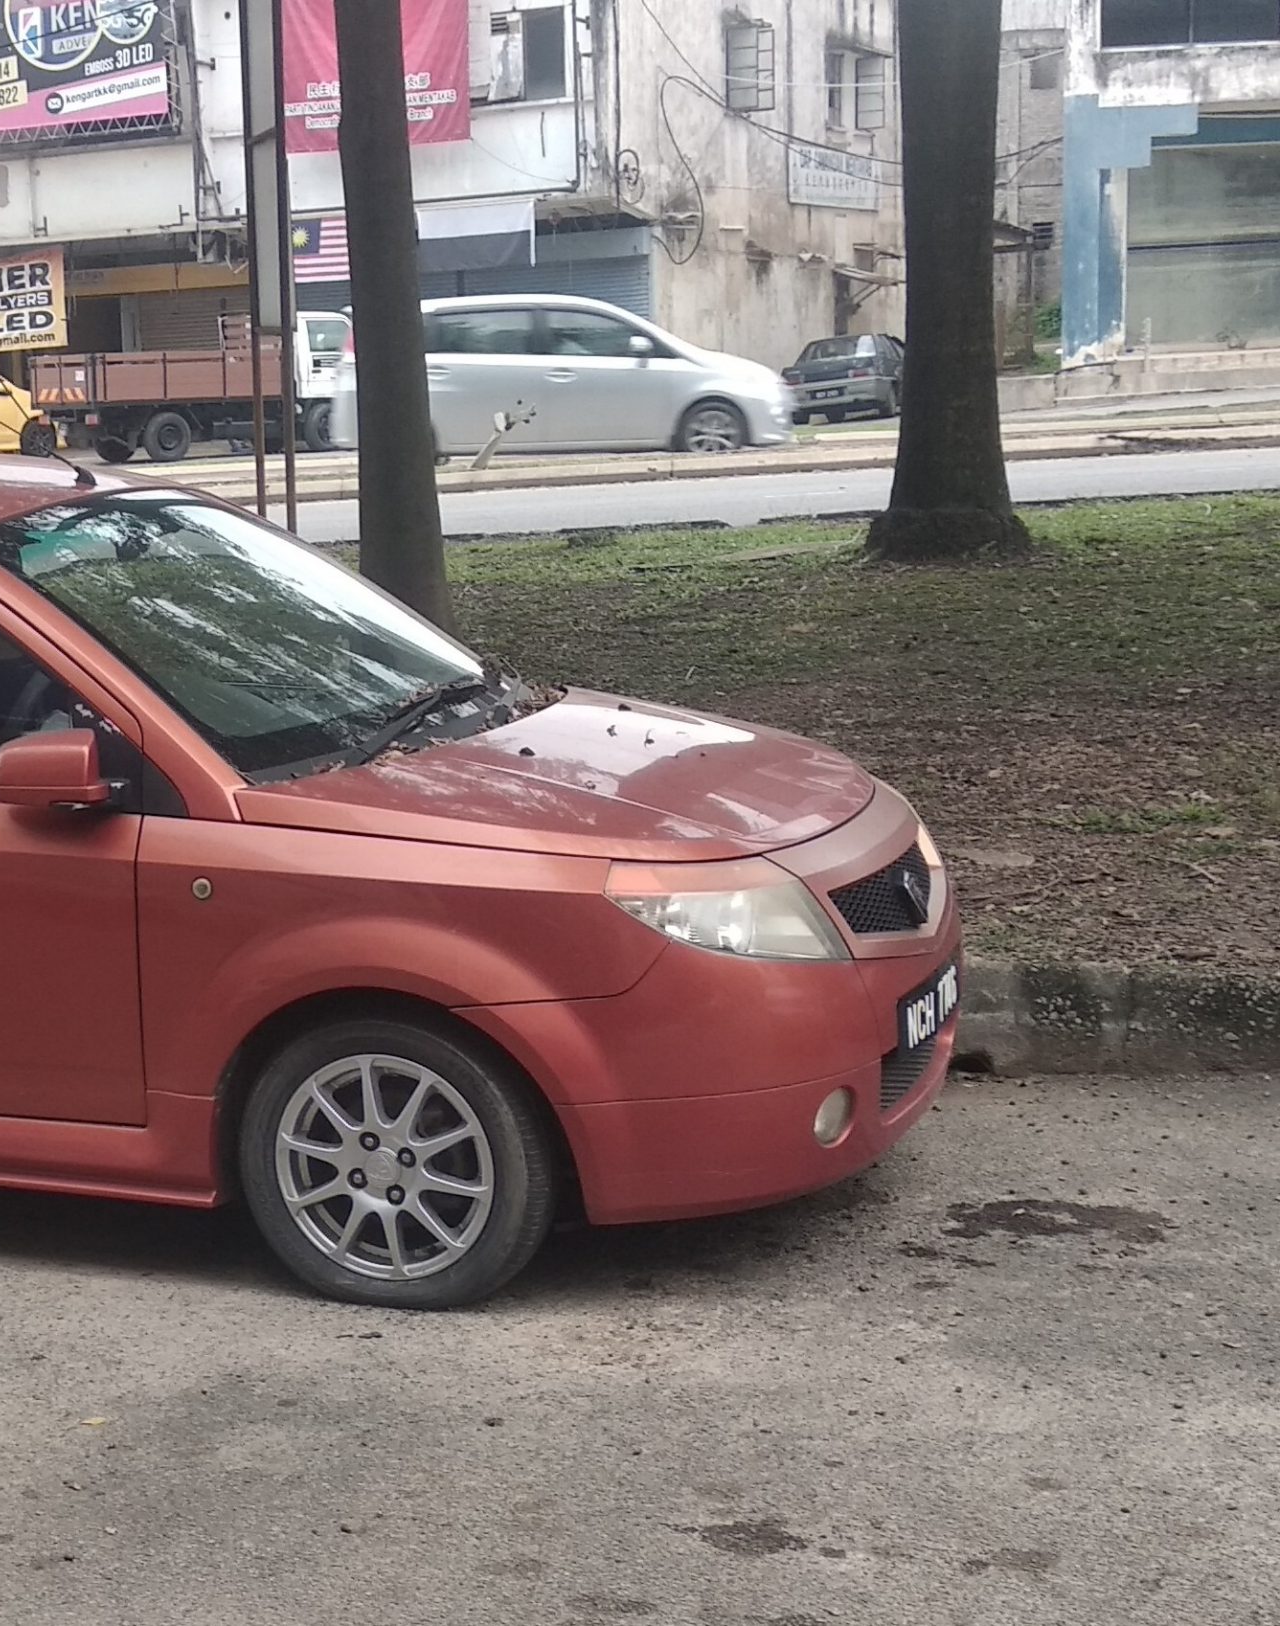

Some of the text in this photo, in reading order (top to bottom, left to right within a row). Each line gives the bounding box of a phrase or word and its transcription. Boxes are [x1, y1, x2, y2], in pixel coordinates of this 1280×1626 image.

[84, 43, 154, 76] EMBOSS 3D LED
[66, 74, 161, 103] kengartkk@gmail.com
[906, 991, 936, 1049] NCH
